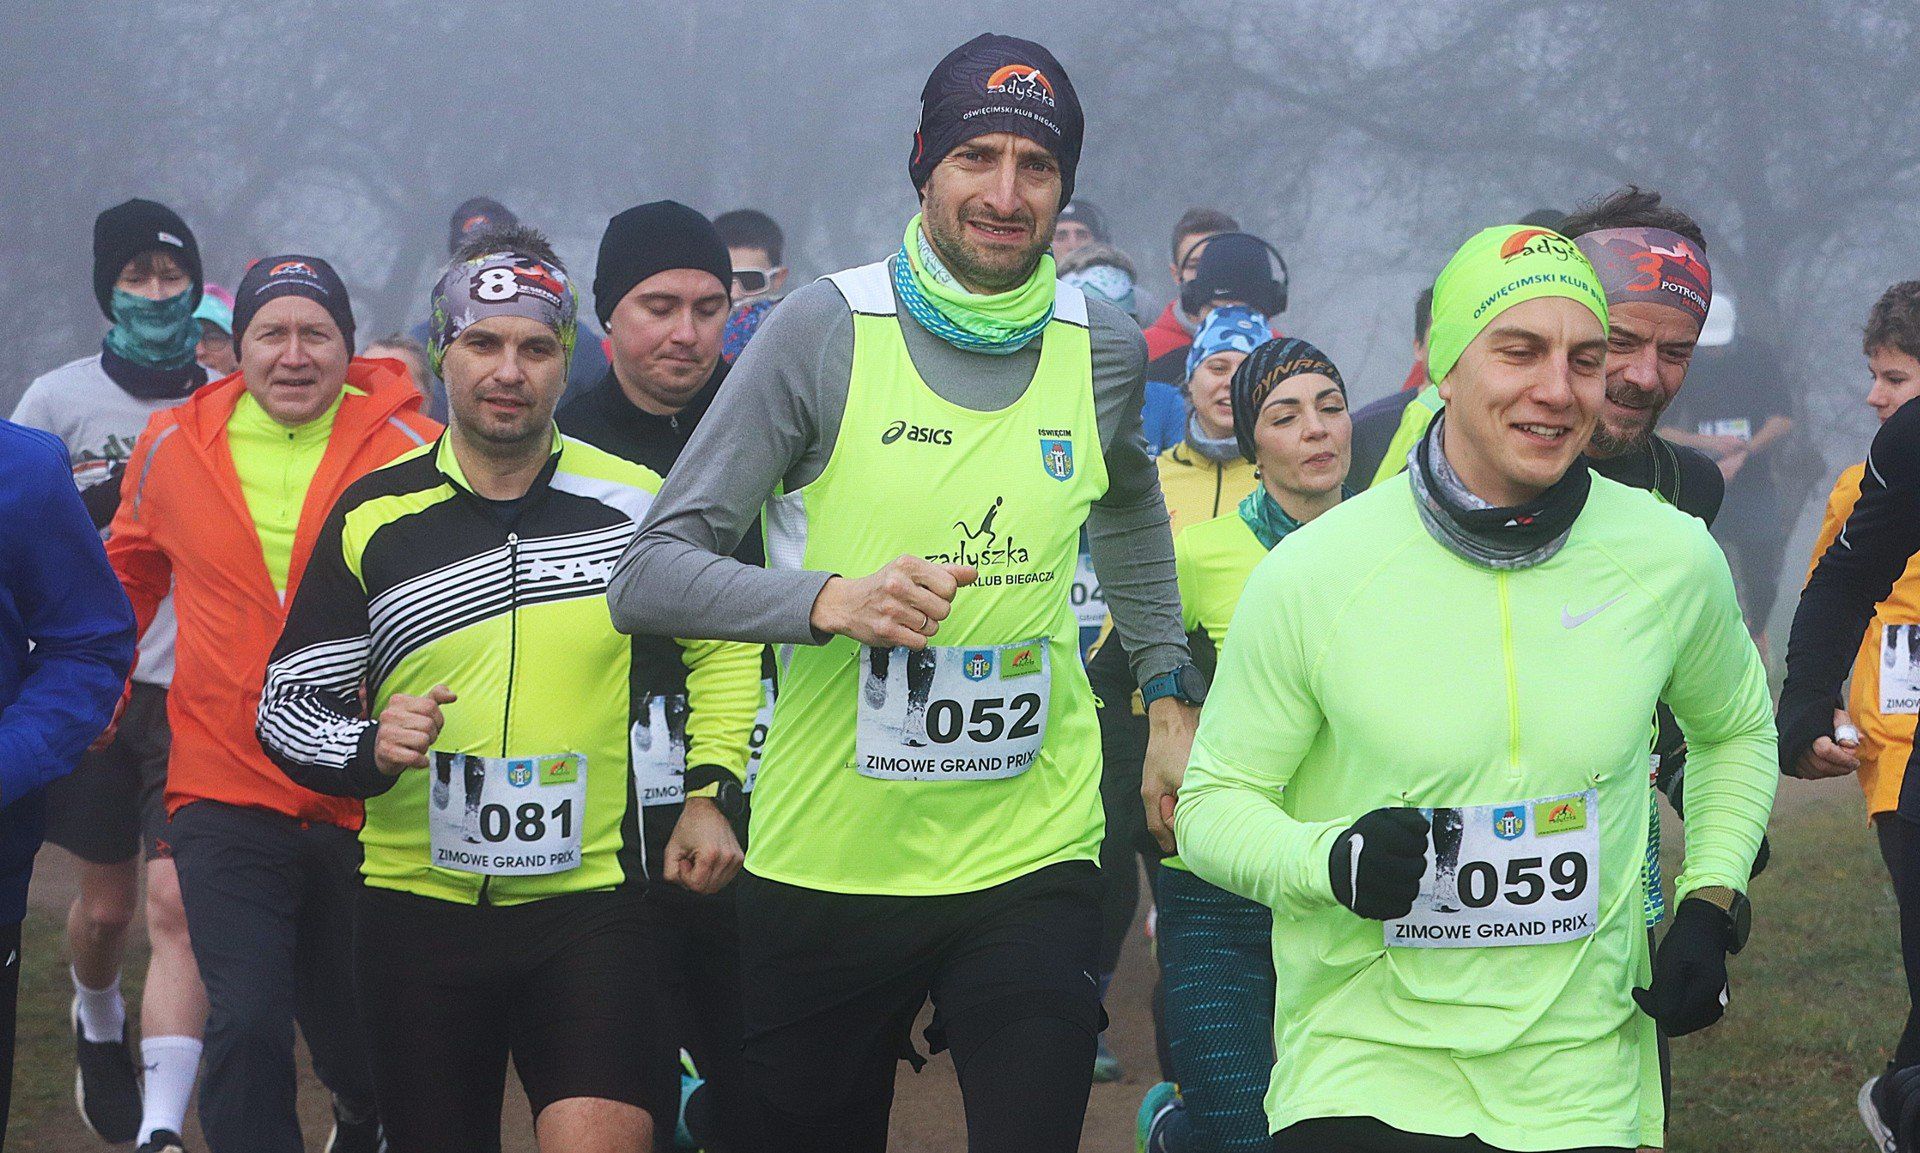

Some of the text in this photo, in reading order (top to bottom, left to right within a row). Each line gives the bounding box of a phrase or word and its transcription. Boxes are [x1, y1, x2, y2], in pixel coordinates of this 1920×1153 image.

[986, 80, 1055, 107] zadyszka
[963, 106, 1061, 136] OŚWIĘCIMSKI KLUB BIEGACZA
[478, 268, 519, 301] 8
[1626, 251, 1664, 292] 3
[1473, 273, 1555, 319] OŚWIĘCIMSKI
[1560, 274, 1588, 291] KLUB
[907, 425, 953, 446] asics
[1005, 571, 1055, 585] BIEGACZA
[1887, 699, 1920, 709] ZIMO
[925, 692, 1041, 744] 052
[866, 749, 1036, 773] ZIMOWE GRAND PRIX
[644, 784, 684, 800] ZIMO
[479, 799, 572, 843] 081
[438, 848, 574, 868] ZIMOWE GRAND PRIX
[1457, 851, 1588, 909] 059
[1395, 913, 1588, 939] ZIMOWE GRAND PRIX
